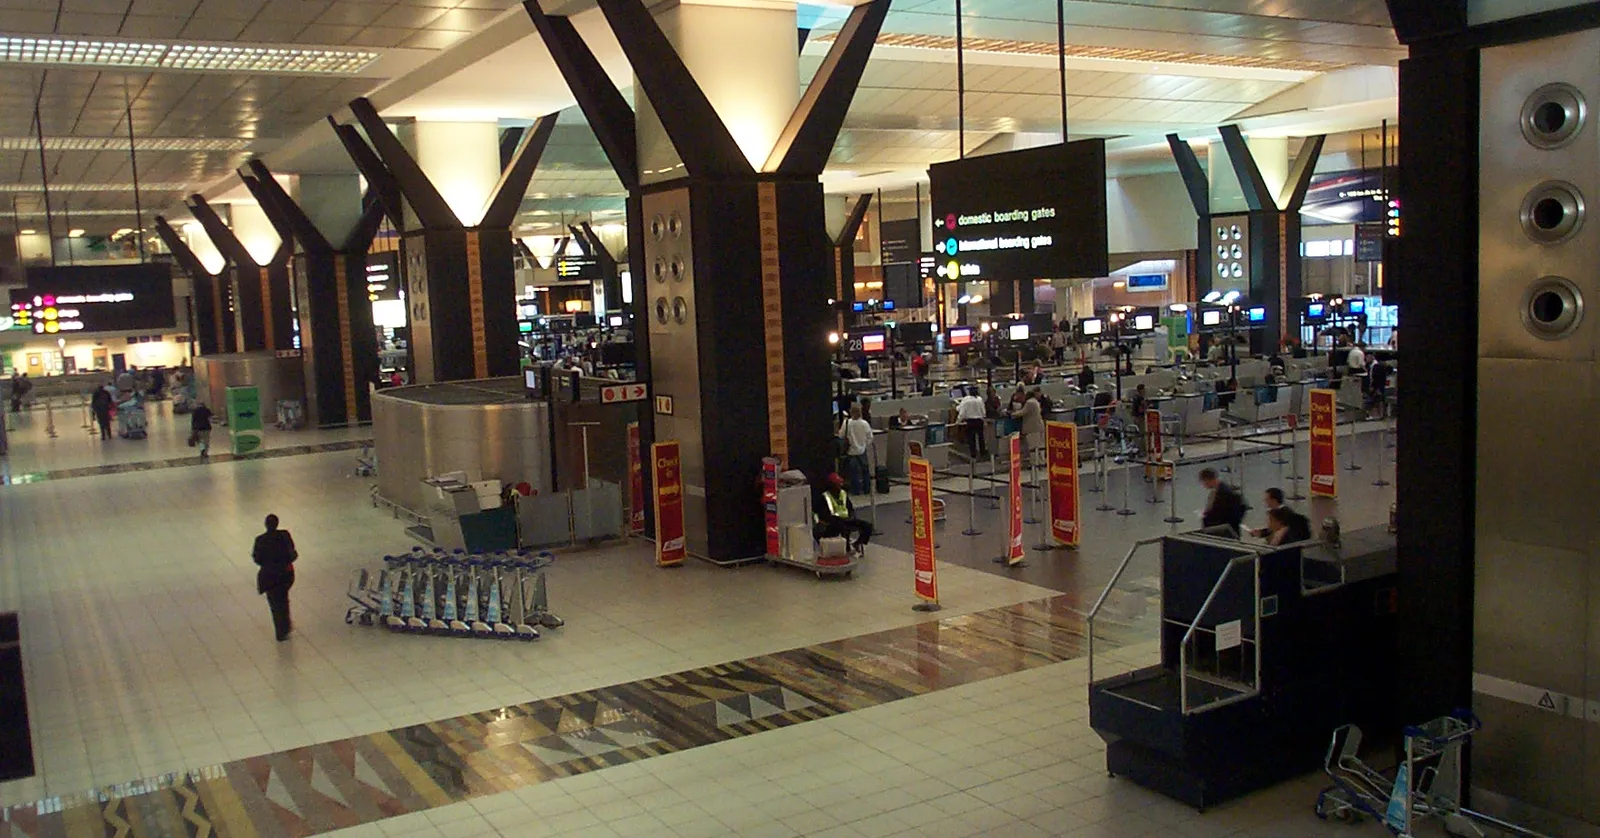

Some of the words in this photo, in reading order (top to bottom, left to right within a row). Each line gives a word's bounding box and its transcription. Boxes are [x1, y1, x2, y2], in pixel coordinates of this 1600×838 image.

[958, 213, 992, 226] domestic
[994, 209, 1029, 223] boarding
[1031, 207, 1056, 221] gates
[971, 331, 983, 342] 29
[998, 328, 1009, 340] 30
[850, 339, 862, 351] 28
[1048, 437, 1071, 450] Check
[1056, 448, 1064, 459] in
